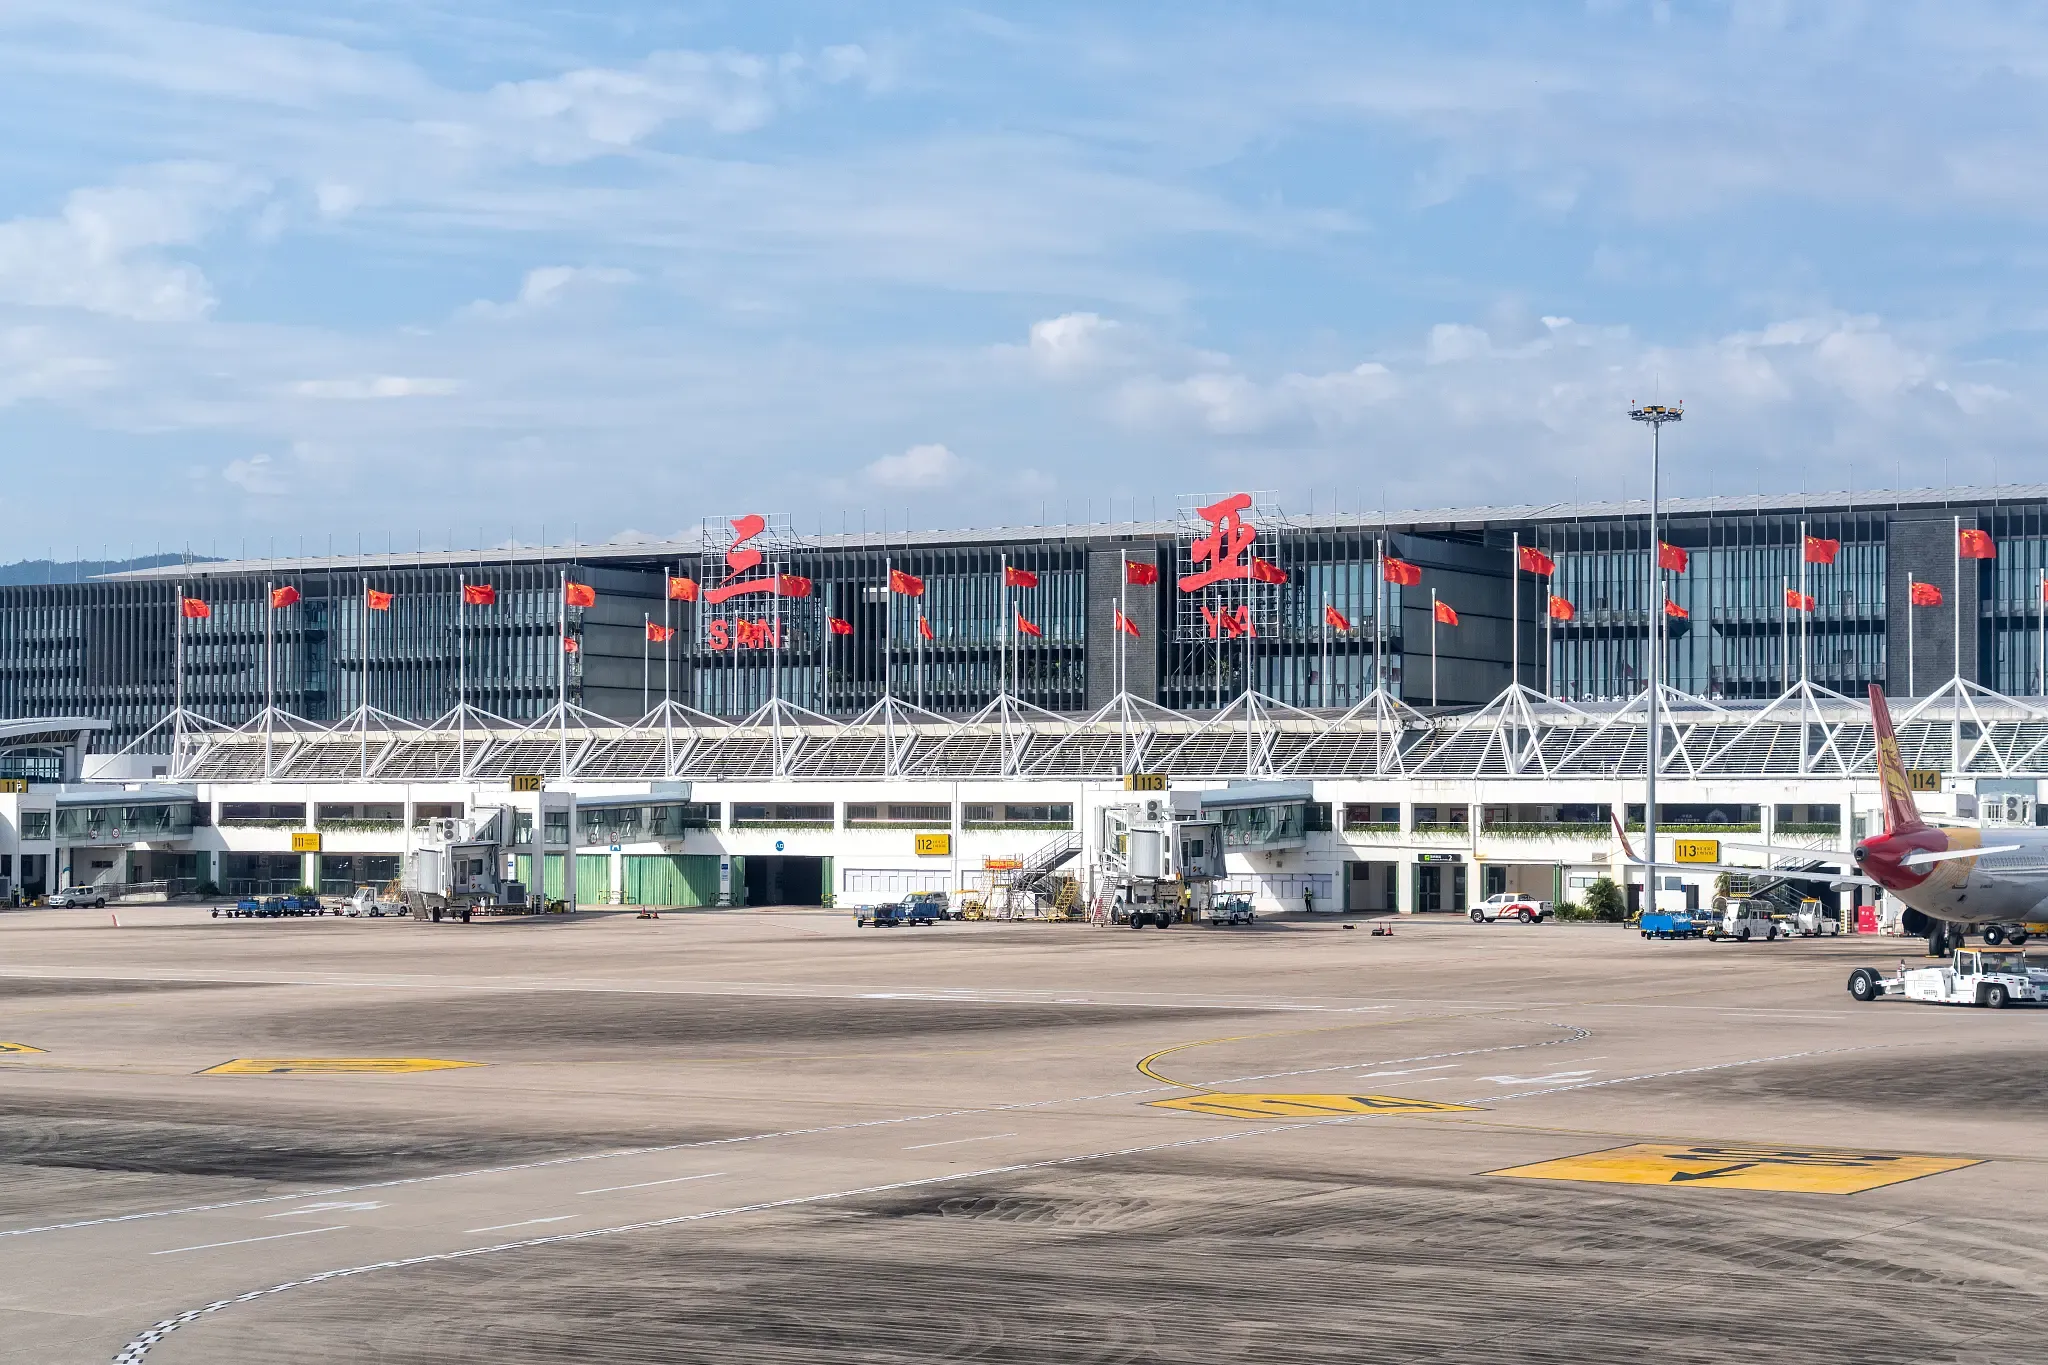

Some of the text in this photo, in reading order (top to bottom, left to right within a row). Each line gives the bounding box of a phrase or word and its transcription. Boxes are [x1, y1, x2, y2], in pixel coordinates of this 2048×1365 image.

[1179, 493, 1256, 592] 亚
[703, 514, 775, 604] 三
[1200, 605, 1257, 639] YA
[519, 778, 539, 790] 112
[1142, 777, 1163, 790] 113
[1913, 773, 1935, 788] 114
[295, 837, 304, 847] 111
[917, 839, 932, 850] 112
[1678, 845, 1697, 857] 113
